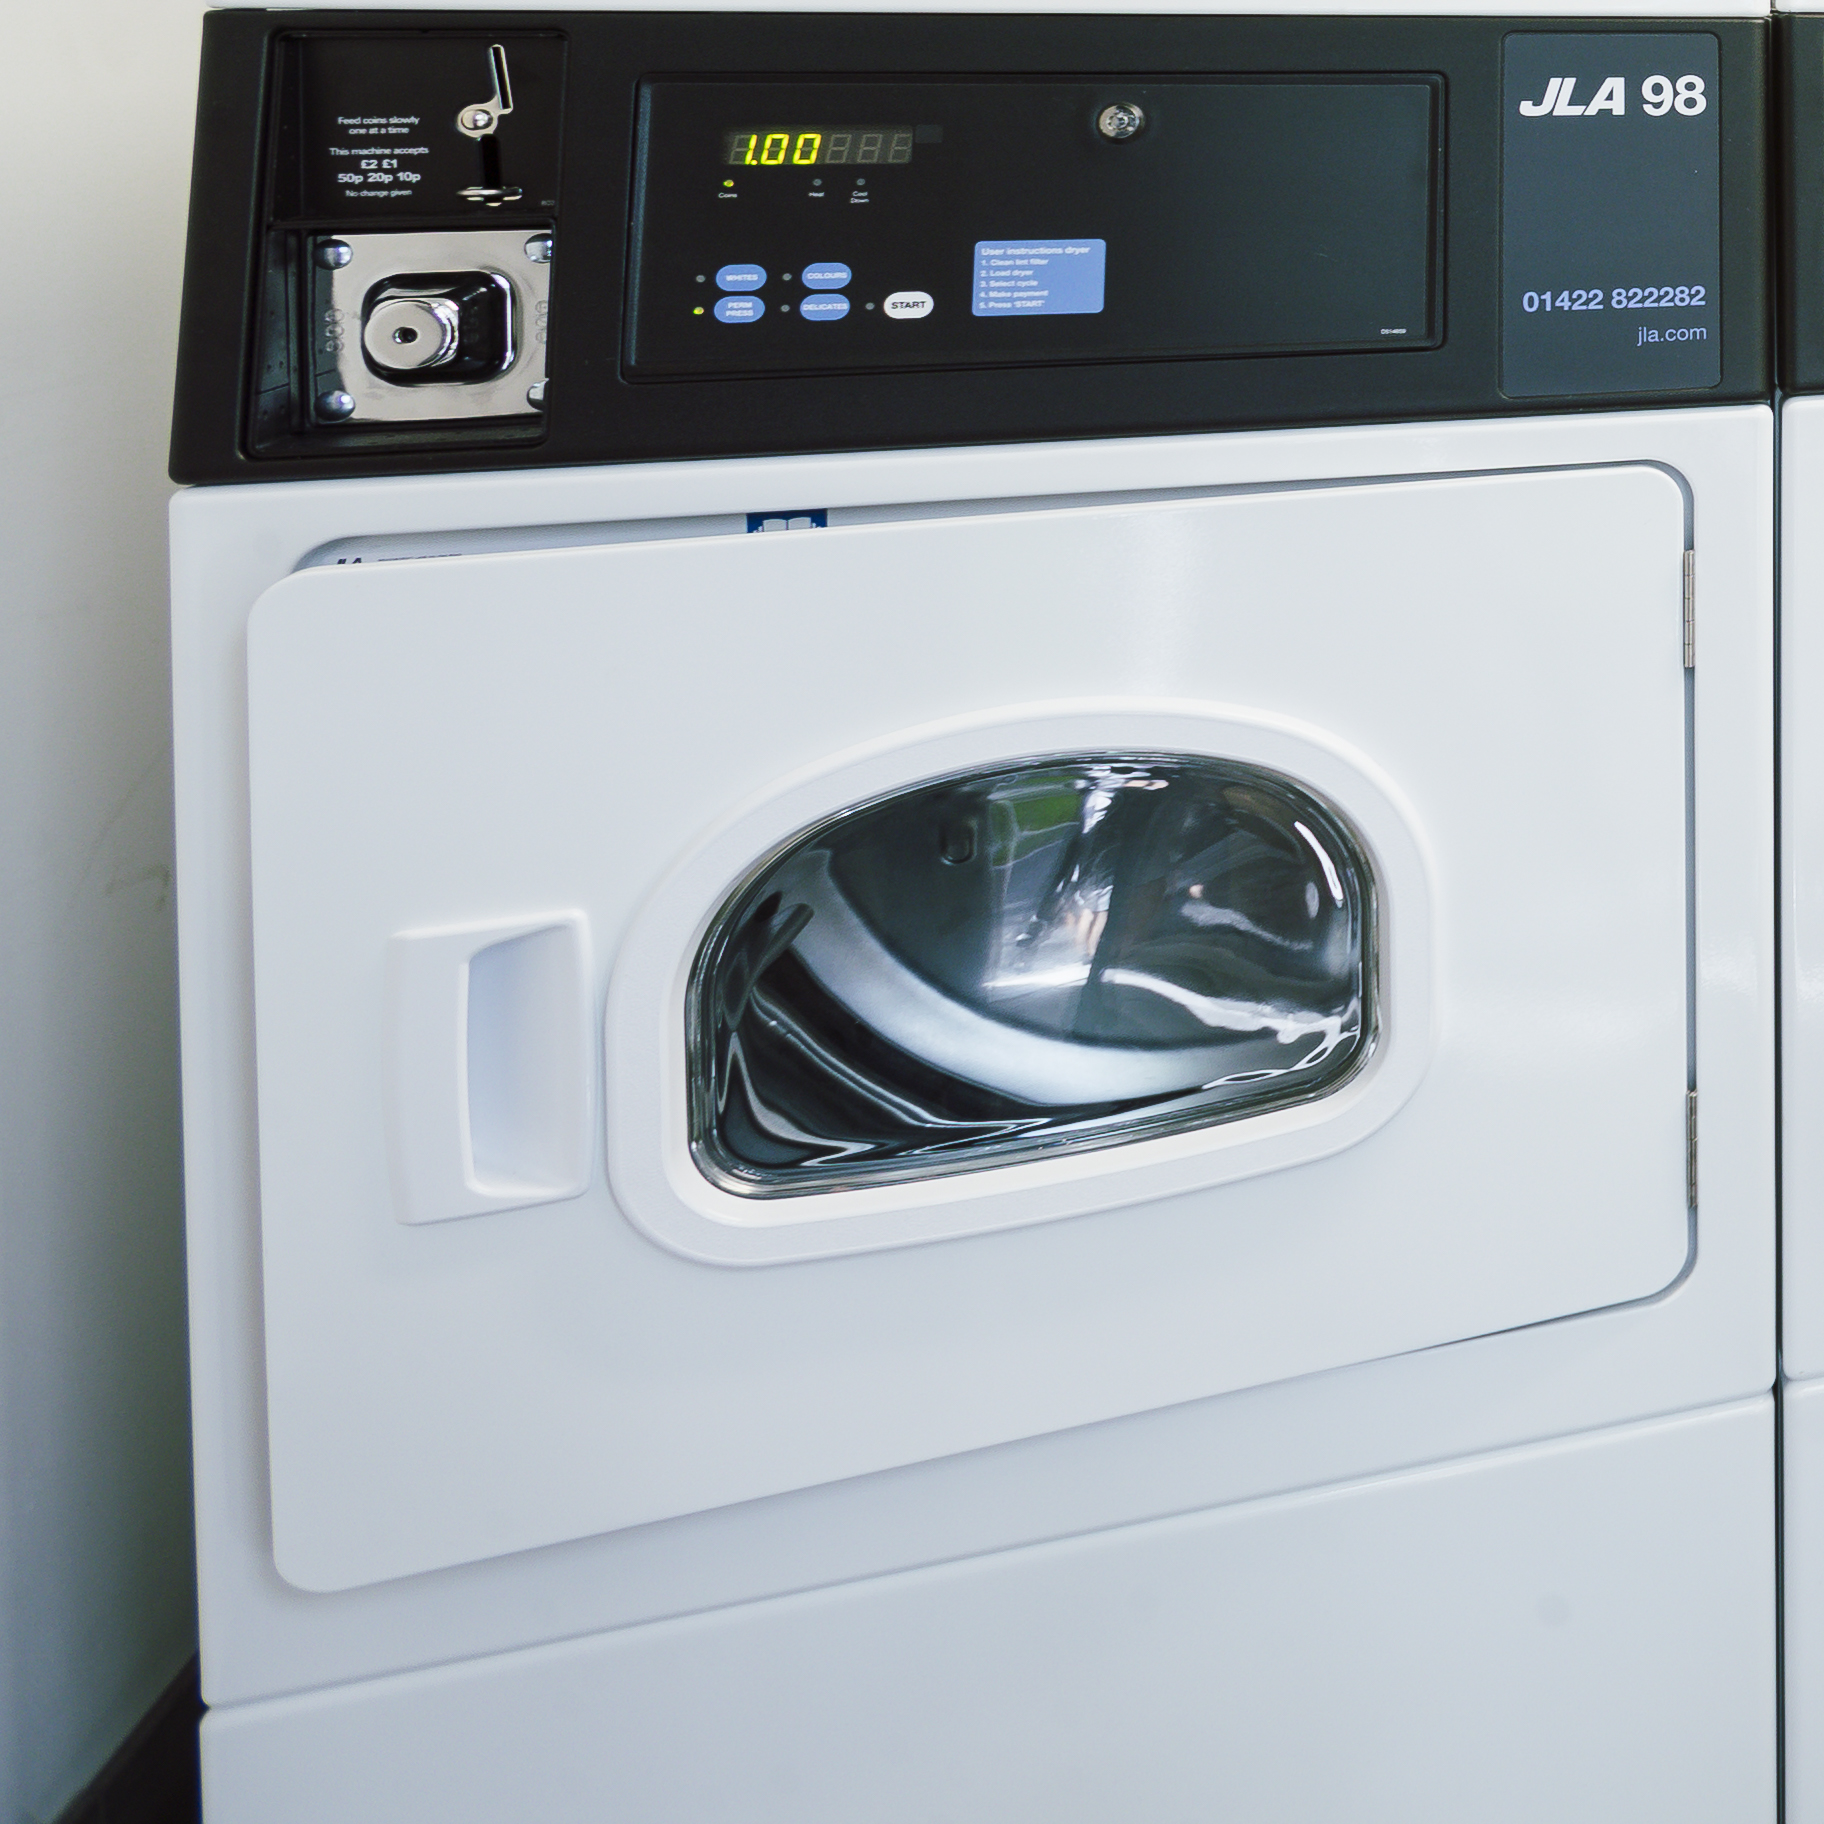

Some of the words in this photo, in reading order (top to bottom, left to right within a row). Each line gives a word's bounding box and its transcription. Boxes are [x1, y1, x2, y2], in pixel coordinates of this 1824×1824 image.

[1519, 77, 1625, 116] JLA
[1641, 74, 1707, 116] 98
[337, 116, 361, 124] Feed
[363, 116, 387, 124] coins
[389, 116, 420, 125] slowly
[388, 126, 409, 134] time
[351, 147, 392, 155] machine
[393, 147, 429, 155] accepts
[745, 134, 822, 165] 1.00
[361, 160, 378, 169] £2
[382, 159, 398, 168] £1
[337, 173, 364, 184] 50p
[367, 173, 393, 183] 20p
[396, 172, 421, 183] 10p
[390, 189, 412, 197] given
[981, 248, 1004, 256] User
[1006, 247, 1063, 255] instructions
[1064, 246, 1091, 256] dryer
[807, 272, 848, 280] COLOURS
[1012, 269, 1034, 277] dryer
[1013, 290, 1049, 298] payment
[1523, 290, 1604, 313] 01422
[1611, 286, 1706, 309] 822282
[891, 301, 927, 309] START
[1637, 327, 1707, 346] jla.com
